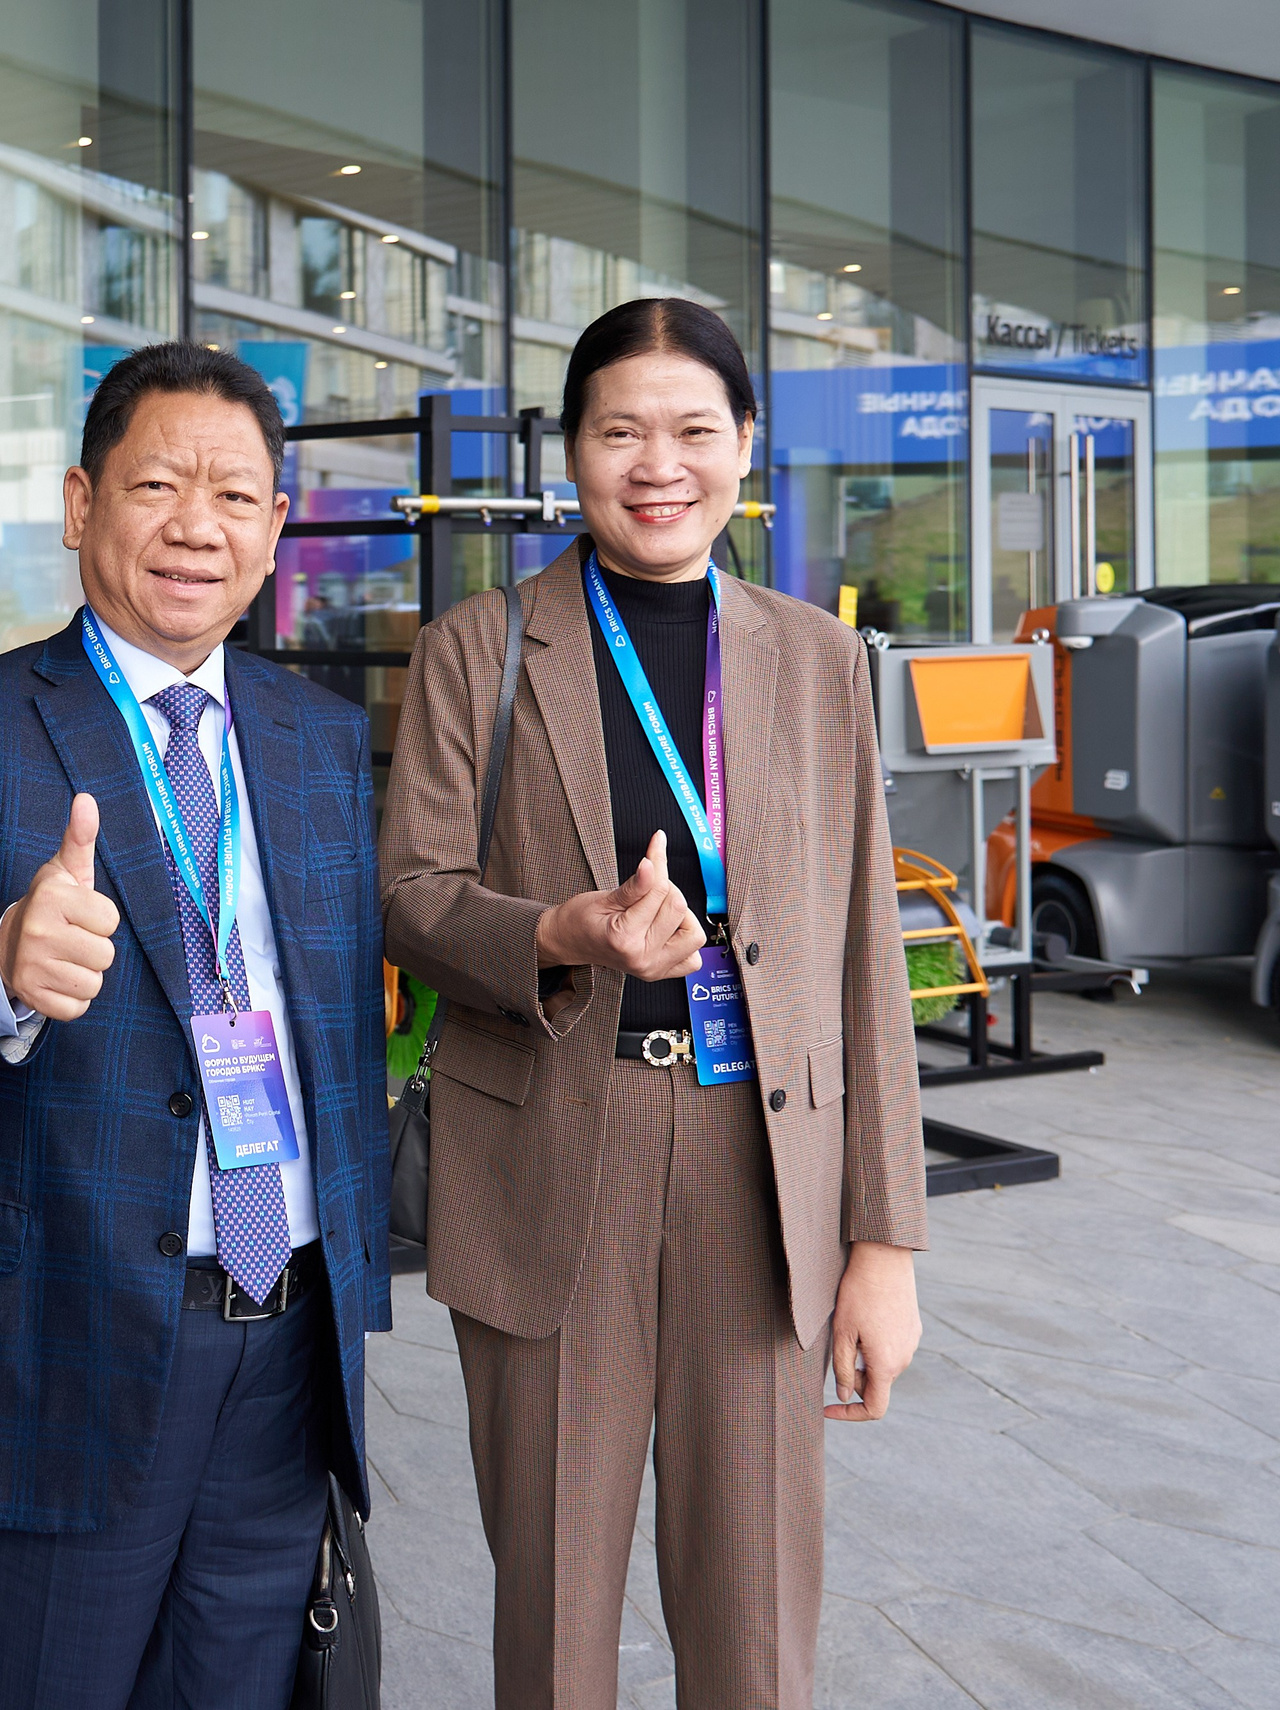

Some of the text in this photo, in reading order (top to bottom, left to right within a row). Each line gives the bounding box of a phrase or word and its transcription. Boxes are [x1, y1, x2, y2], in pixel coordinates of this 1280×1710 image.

[986, 315, 1050, 349] Кассы
[1071, 323, 1138, 360] Tickets
[604, 607, 620, 632] BRICS
[94, 643, 112, 669] BRICS
[708, 707, 716, 735] BRICS
[643, 701, 706, 833] BRICS URBAN FUTURE FORUM
[708, 738, 718, 770] URBAN
[710, 772, 720, 810] FUTURE
[142, 742, 200, 889] BRICS URBAN FUTURE FORUM
[222, 768, 234, 906] BRICS URBAN FUTURE FORUM
[710, 984, 731, 994] BRICS
[712, 993, 738, 1002] FUTURE
[204, 1053, 276, 1068] ФОРУМ О БУДУЩЕМ
[206, 1064, 266, 1077] ГОРОДОВ БРИКС
[713, 1060, 756, 1074] DELEGAT
[235, 1140, 279, 1158] ДЕЛЕГАТ
